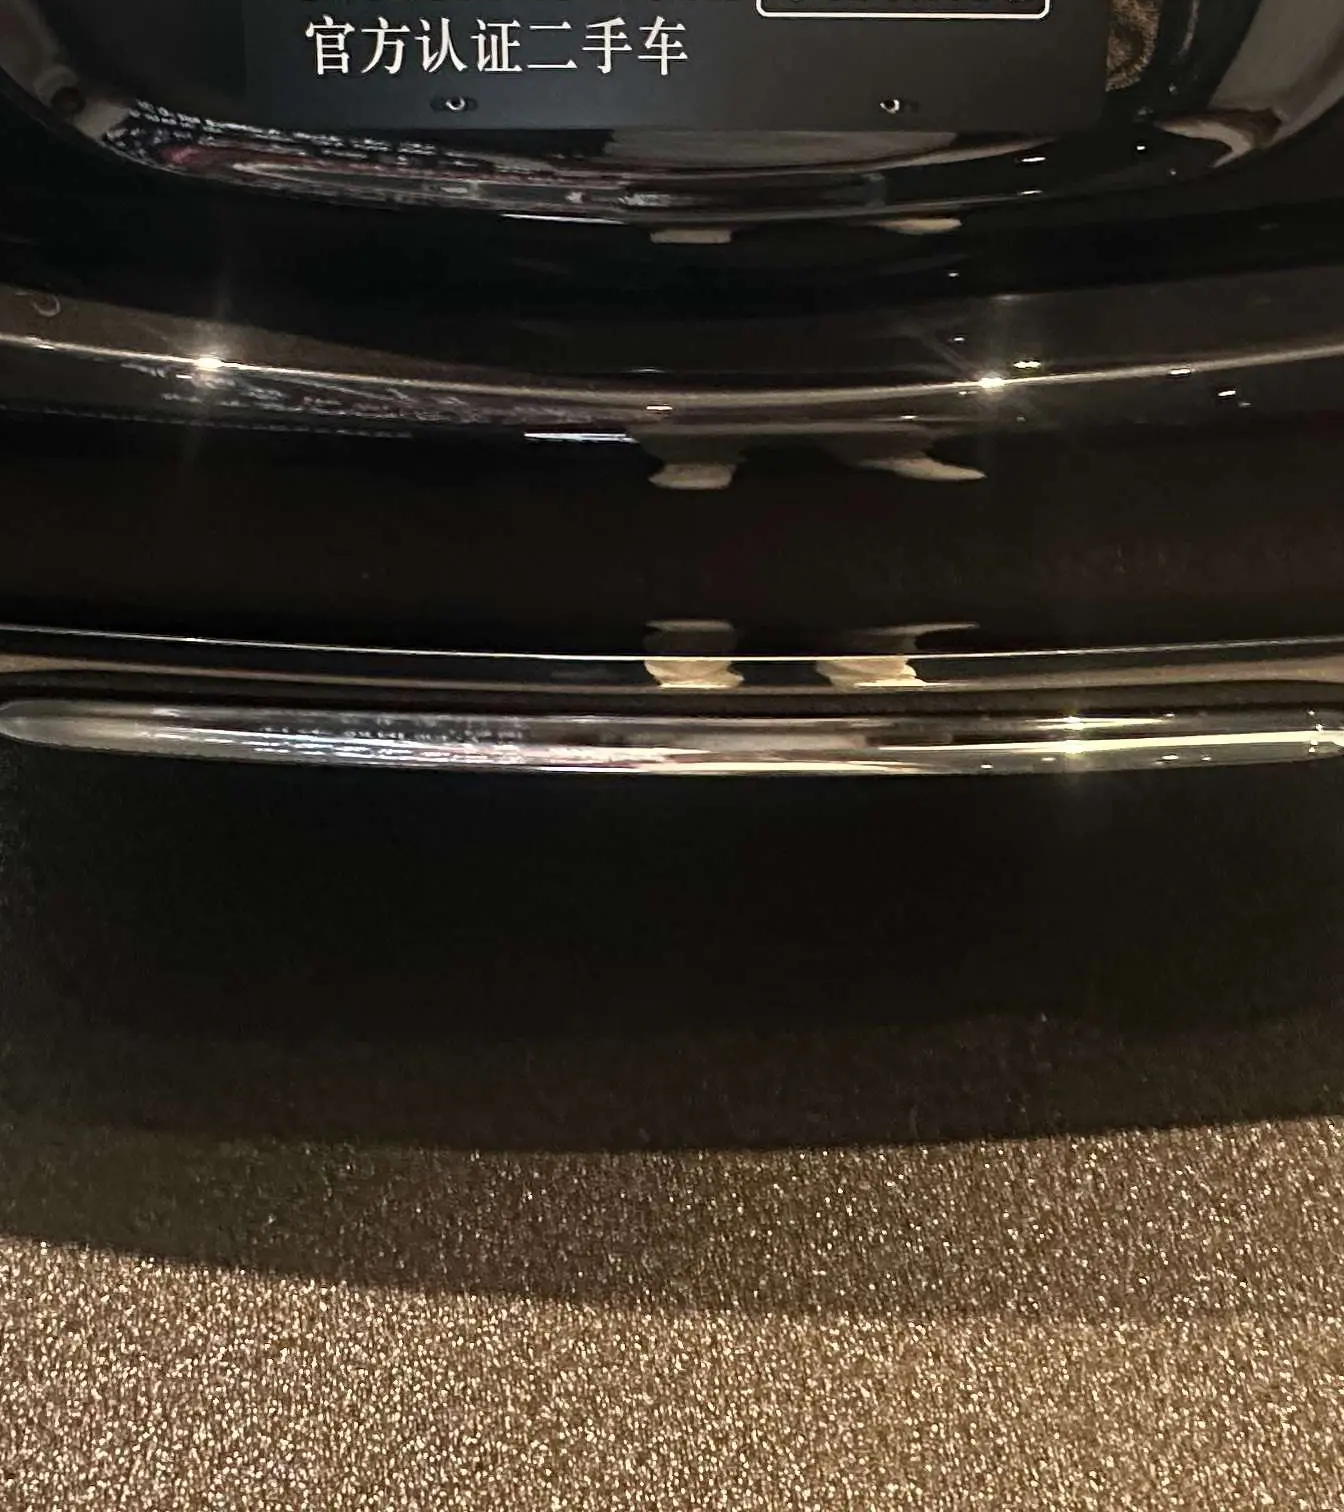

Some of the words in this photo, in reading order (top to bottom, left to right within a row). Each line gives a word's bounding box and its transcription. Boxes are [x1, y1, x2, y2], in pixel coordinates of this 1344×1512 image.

[304, 16, 689, 76] 官方认证二手车
